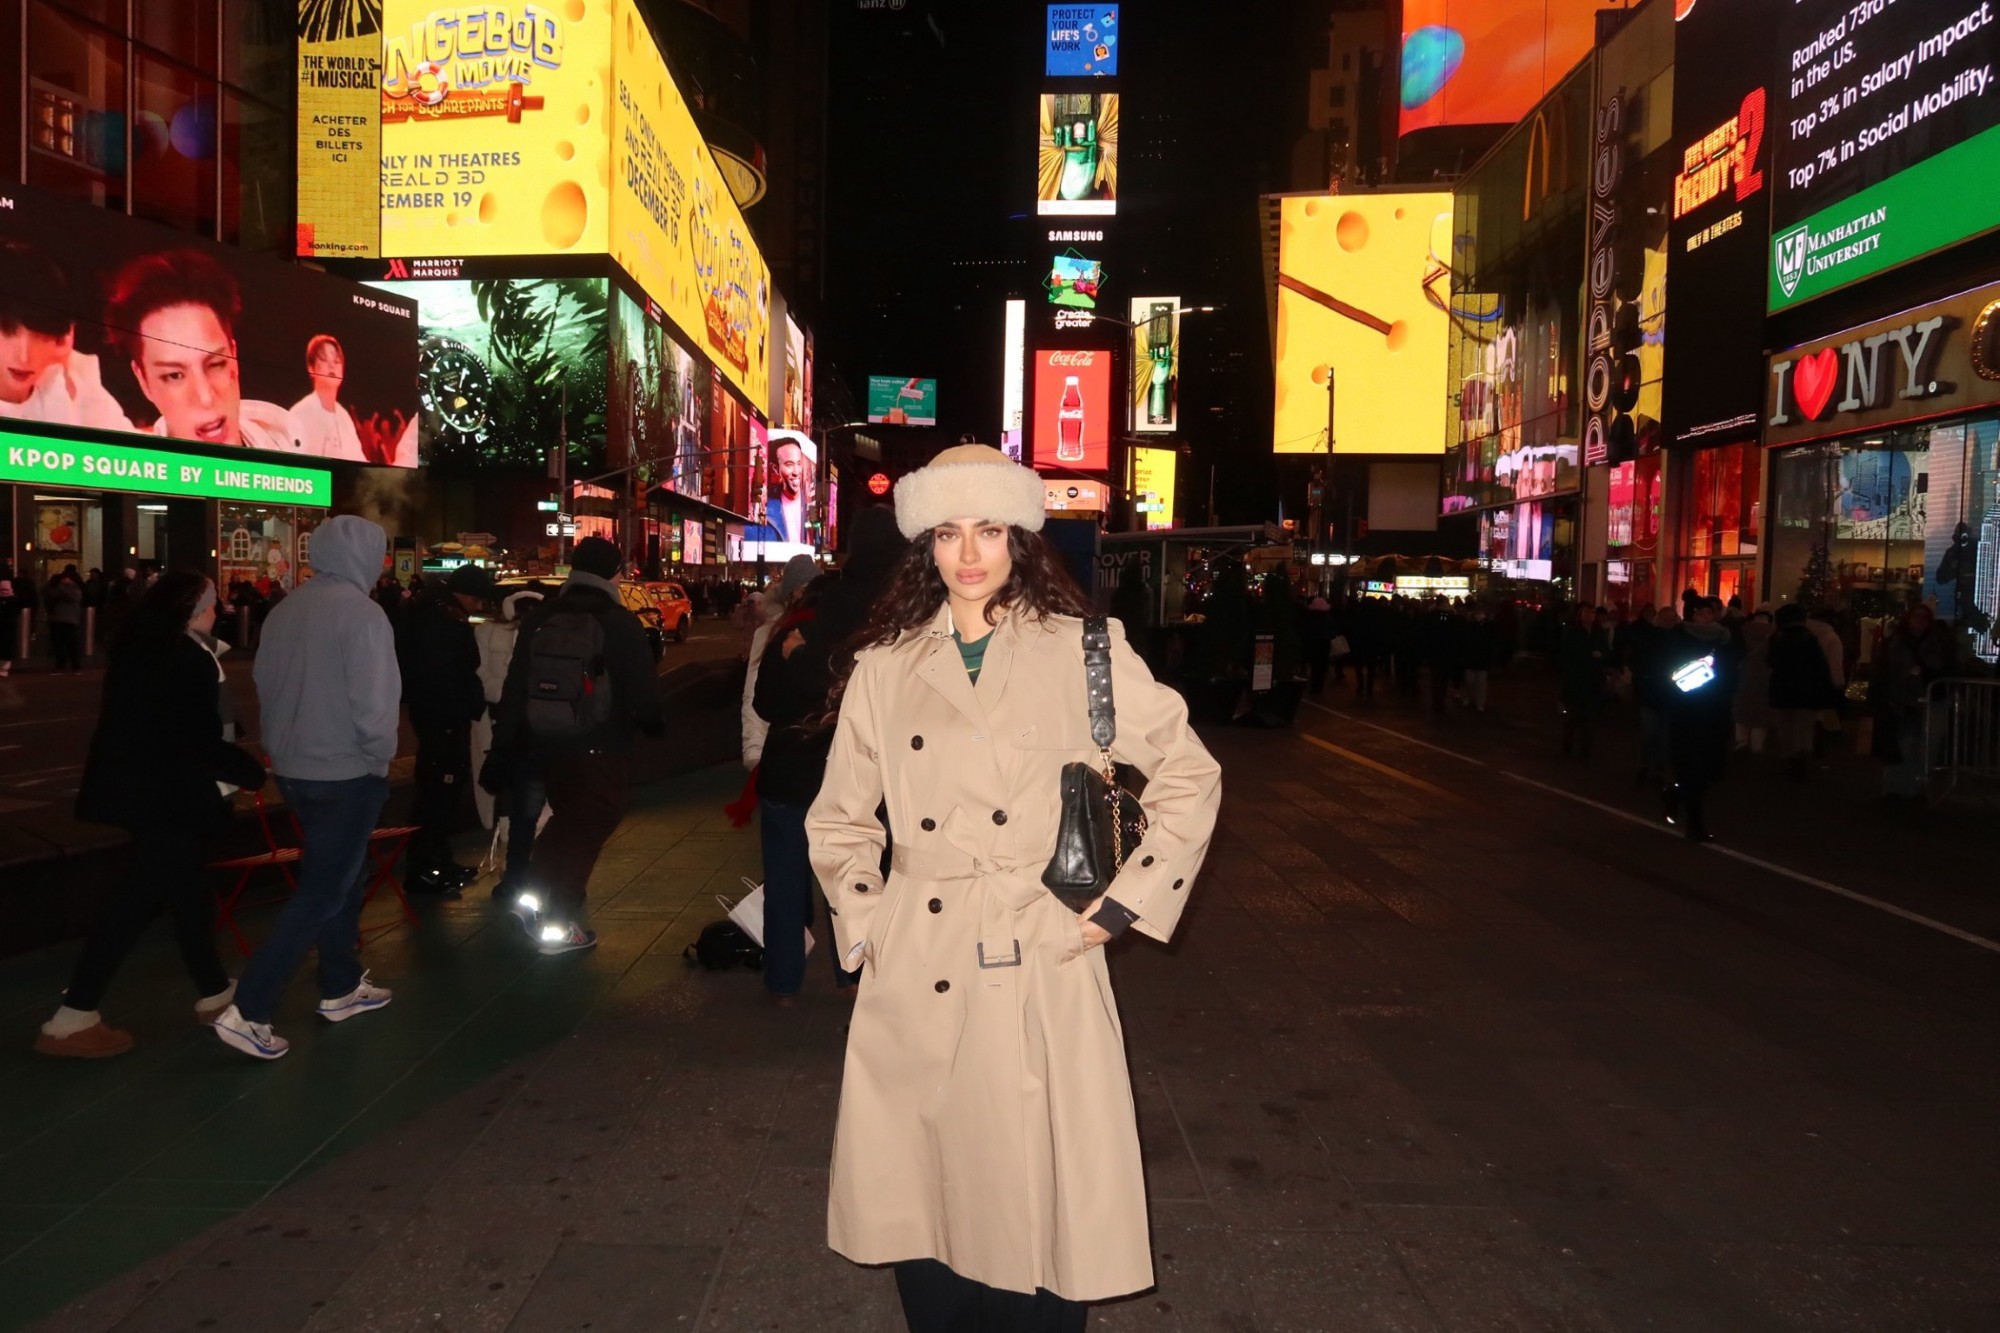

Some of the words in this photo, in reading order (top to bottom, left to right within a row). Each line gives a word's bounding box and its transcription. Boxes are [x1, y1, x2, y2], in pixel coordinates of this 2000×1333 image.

[1052, 8, 1096, 20] PROTECT
[1051, 20, 1079, 30] YOUR
[1051, 30, 1080, 41] LIFE'S
[1792, 15, 1846, 72] Ranked
[1051, 41, 1081, 52] WORK
[303, 55, 324, 69] THE
[327, 56, 376, 71] WORLD'S
[1790, 112, 1816, 140] Top
[1819, 94, 1840, 123] 3%
[1843, 86, 1857, 109] in
[1860, 50, 1915, 97] Salary
[1918, 1, 1994, 64] Impact.
[1791, 78, 1804, 99] in
[1807, 60, 1831, 88] the
[1833, 41, 1857, 70] US.
[317, 70, 377, 90] MUSICAL
[456, 56, 533, 89] MOVIE
[418, 99, 506, 118] SQUAREPANTS
[312, 115, 367, 126] ACHETER
[1788, 162, 1815, 189] Top
[1817, 147, 1837, 174] 7%
[1841, 140, 1855, 163] in
[1858, 104, 1909, 152] Social
[1913, 64, 1994, 124] Mobility.
[328, 128, 351, 137] DES
[640, 113, 656, 146] ONLY
[315, 140, 363, 151] BILLETS
[625, 124, 639, 157] AND
[331, 153, 347, 163] ICI
[414, 155, 433, 168] IN
[439, 151, 521, 168] THEATRES
[1674, 137, 1747, 220] FREDDY'S
[1736, 86, 1766, 202] 2
[457, 170, 486, 185] 3D
[453, 191, 473, 207] 19
[627, 154, 669, 237] DECEMBER
[670, 217, 678, 247] 19
[1048, 230, 1104, 242] SAMSUNG
[1807, 206, 1887, 254] MANHATTAN
[1807, 233, 1881, 275] UNIVERSITY
[413, 259, 464, 267] MARRIOTT
[413, 268, 459, 277] MARQUIS
[352, 295, 377, 309] KPOP
[378, 303, 411, 318] SQUARE
[1056, 309, 1091, 319] Create
[1055, 319, 1093, 330] greater
[1770, 360, 1791, 426] I
[9, 447, 75, 471] KPOP
[83, 455, 168, 480] SQUARE
[180, 465, 202, 484] BY
[214, 469, 250, 489] LINE
[253, 473, 314, 494] FRIENDS
